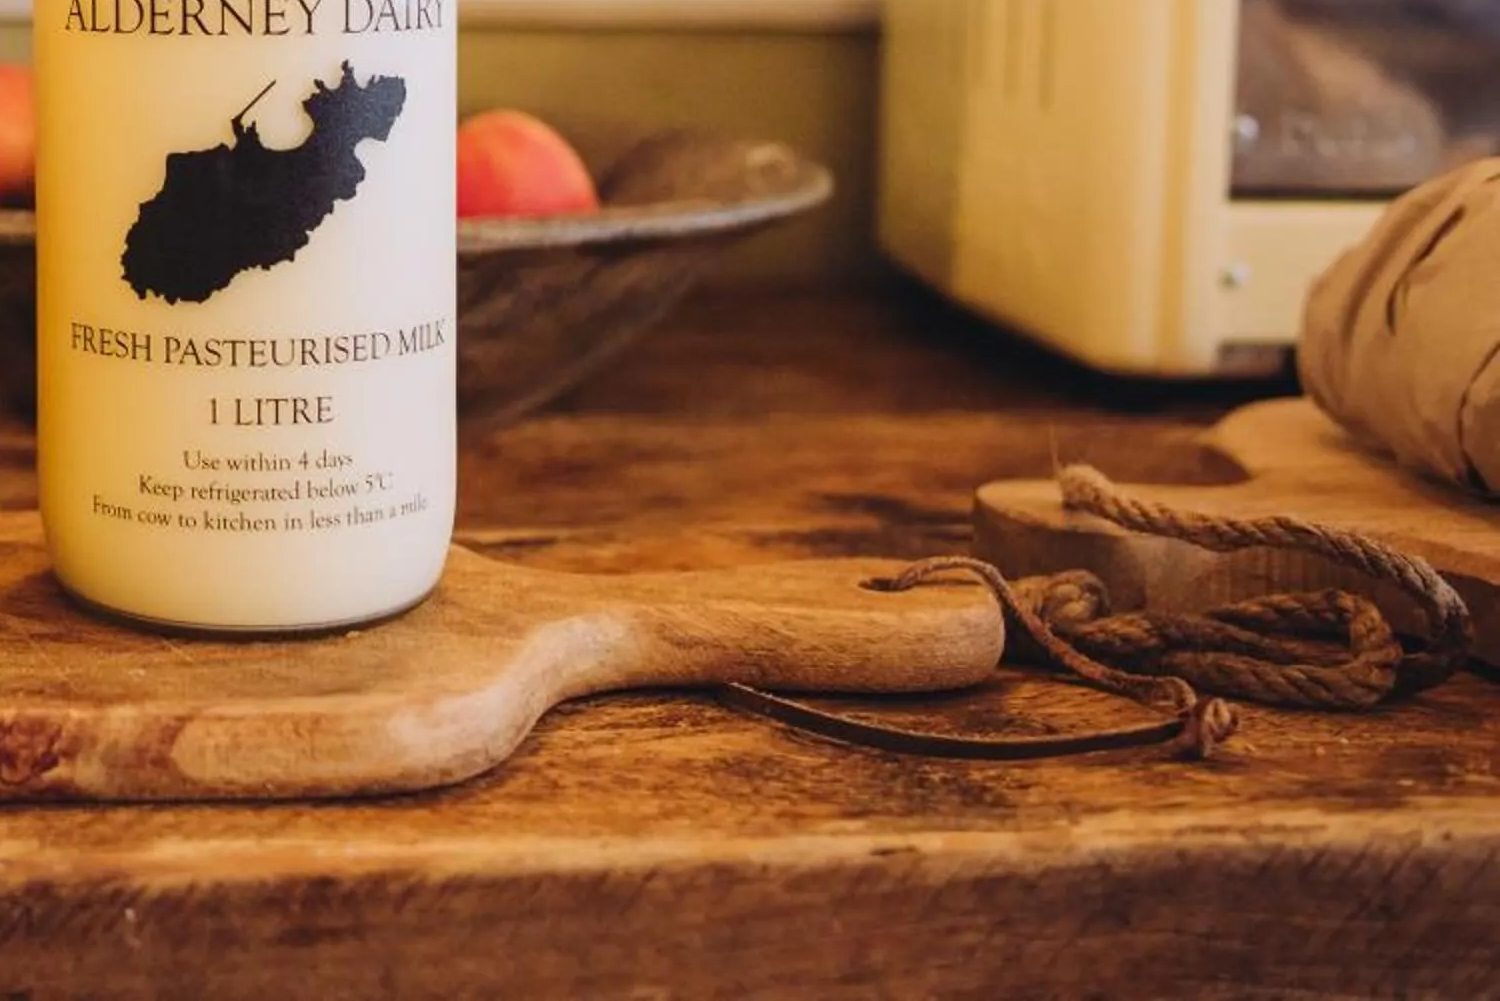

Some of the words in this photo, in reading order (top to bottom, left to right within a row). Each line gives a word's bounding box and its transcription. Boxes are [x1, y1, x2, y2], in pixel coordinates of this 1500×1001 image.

[71, 322, 154, 363] FRESH
[164, 332, 391, 368] PASTEURISED
[399, 318, 446, 356] MILK
[235, 397, 334, 426] LITRE
[183, 450, 220, 470] Use
[227, 452, 291, 472] within
[297, 451, 309, 470] 4
[315, 449, 353, 471] days
[139, 474, 185, 501] Keep
[191, 479, 300, 505] refrigerated
[307, 478, 359, 499] below
[93, 494, 132, 520] From
[137, 510, 172, 526] cow
[179, 513, 197, 529] to
[203, 510, 277, 531] kitchen
[285, 511, 303, 530] in
[310, 510, 341, 529] less
[347, 505, 384, 526] than
[388, 507, 397, 518] a
[401, 492, 428, 516] mile
